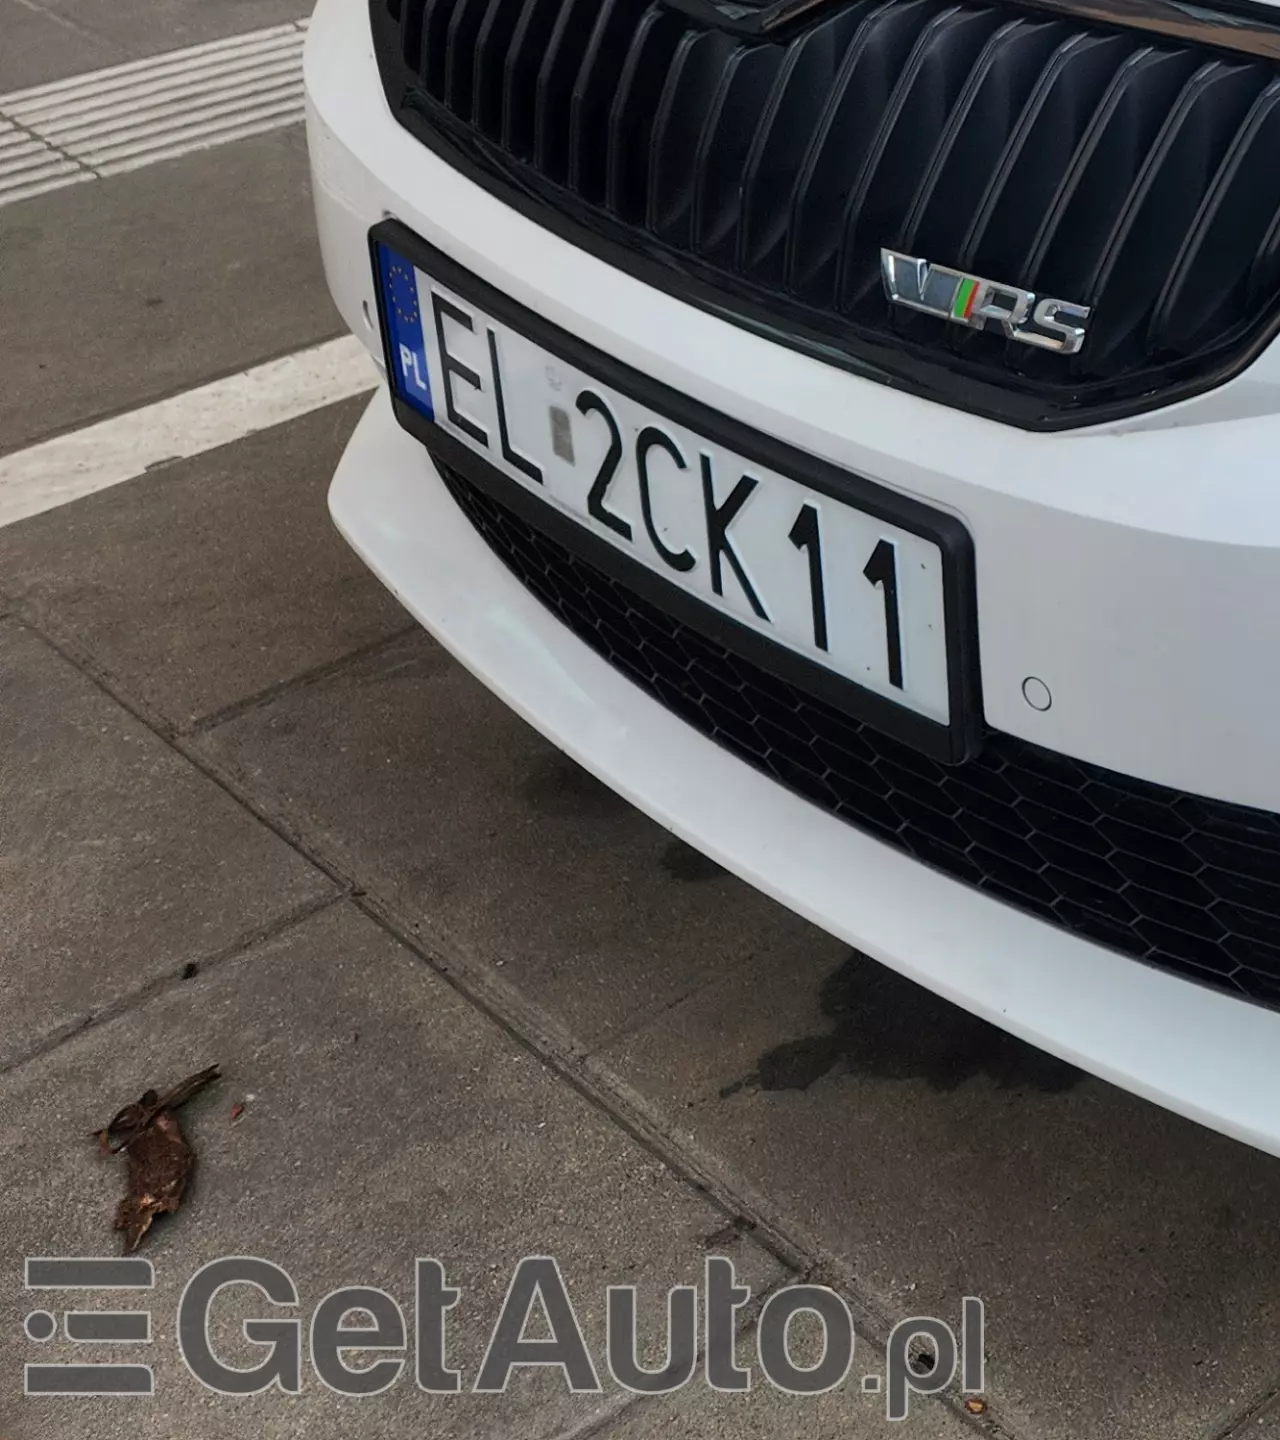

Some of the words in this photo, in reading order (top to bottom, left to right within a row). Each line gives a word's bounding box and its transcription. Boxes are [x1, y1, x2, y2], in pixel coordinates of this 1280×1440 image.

[399, 343, 428, 391] PL
[431, 291, 544, 485] EL
[575, 389, 904, 691] 2CK11
